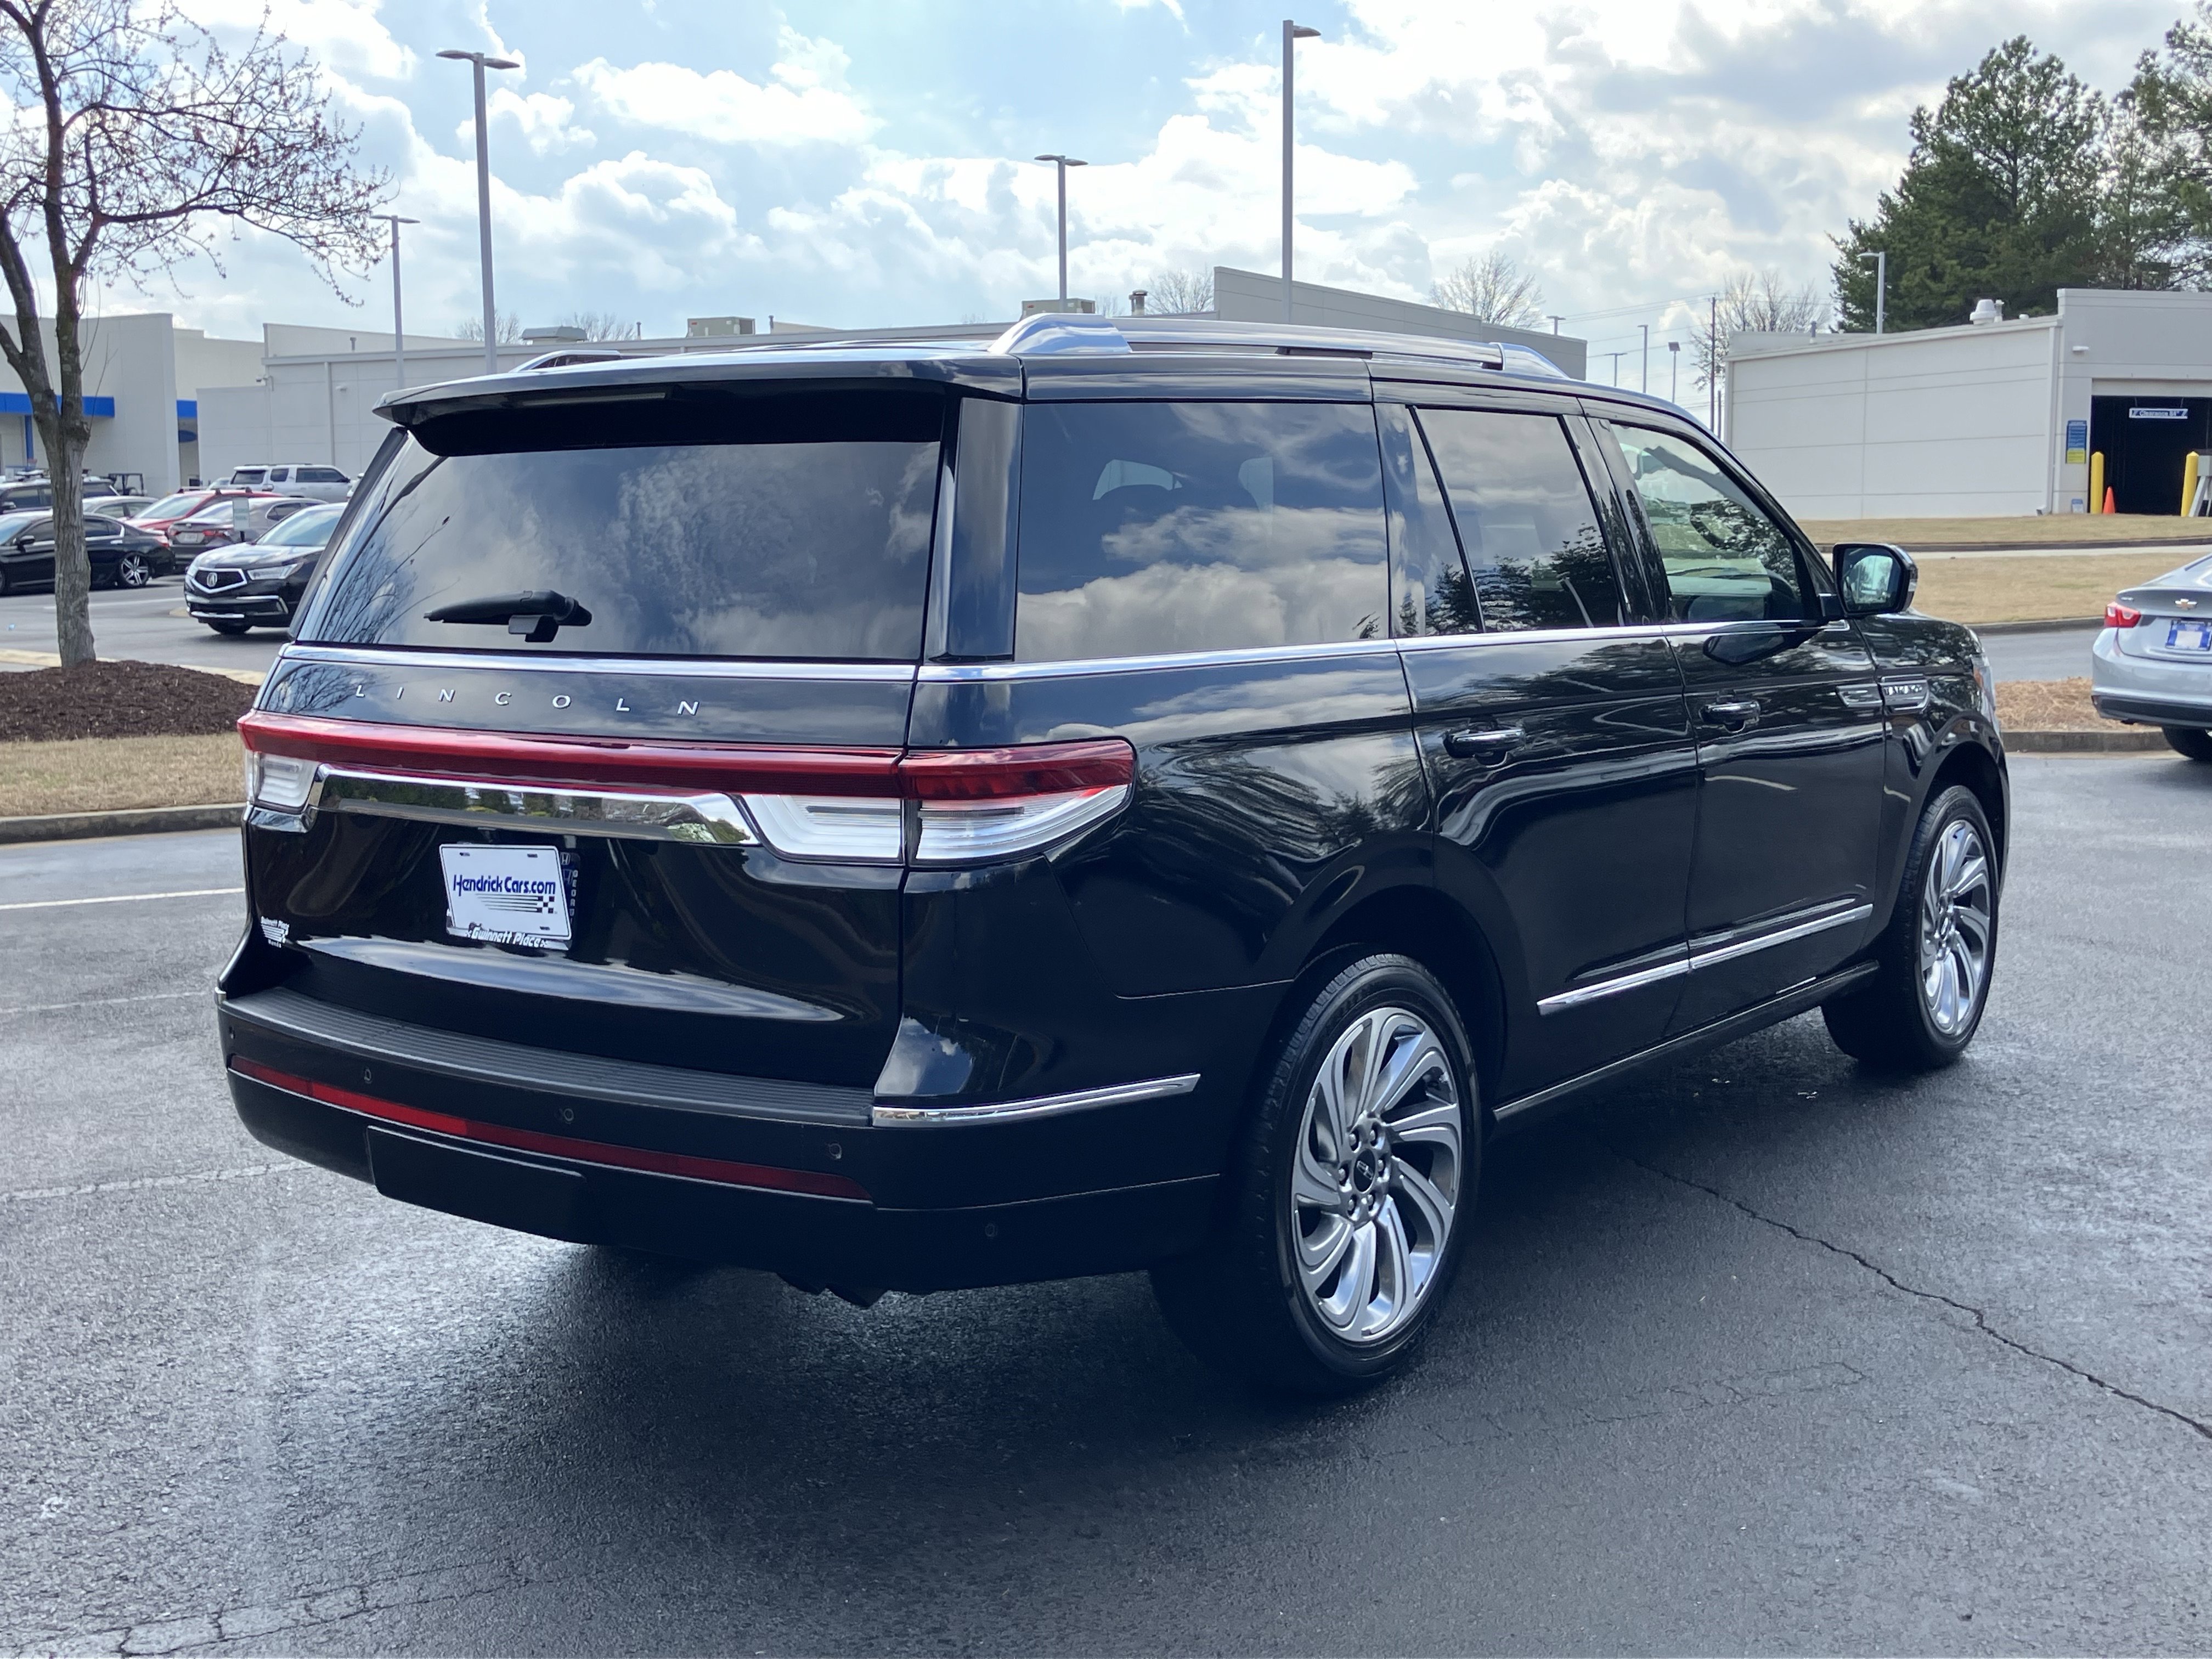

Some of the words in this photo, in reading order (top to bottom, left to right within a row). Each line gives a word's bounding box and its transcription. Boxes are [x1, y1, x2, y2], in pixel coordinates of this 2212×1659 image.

[356, 684, 700, 716] LINCOLN
[472, 926, 512, 945] Gwinnett
[513, 932, 541, 948] Place
